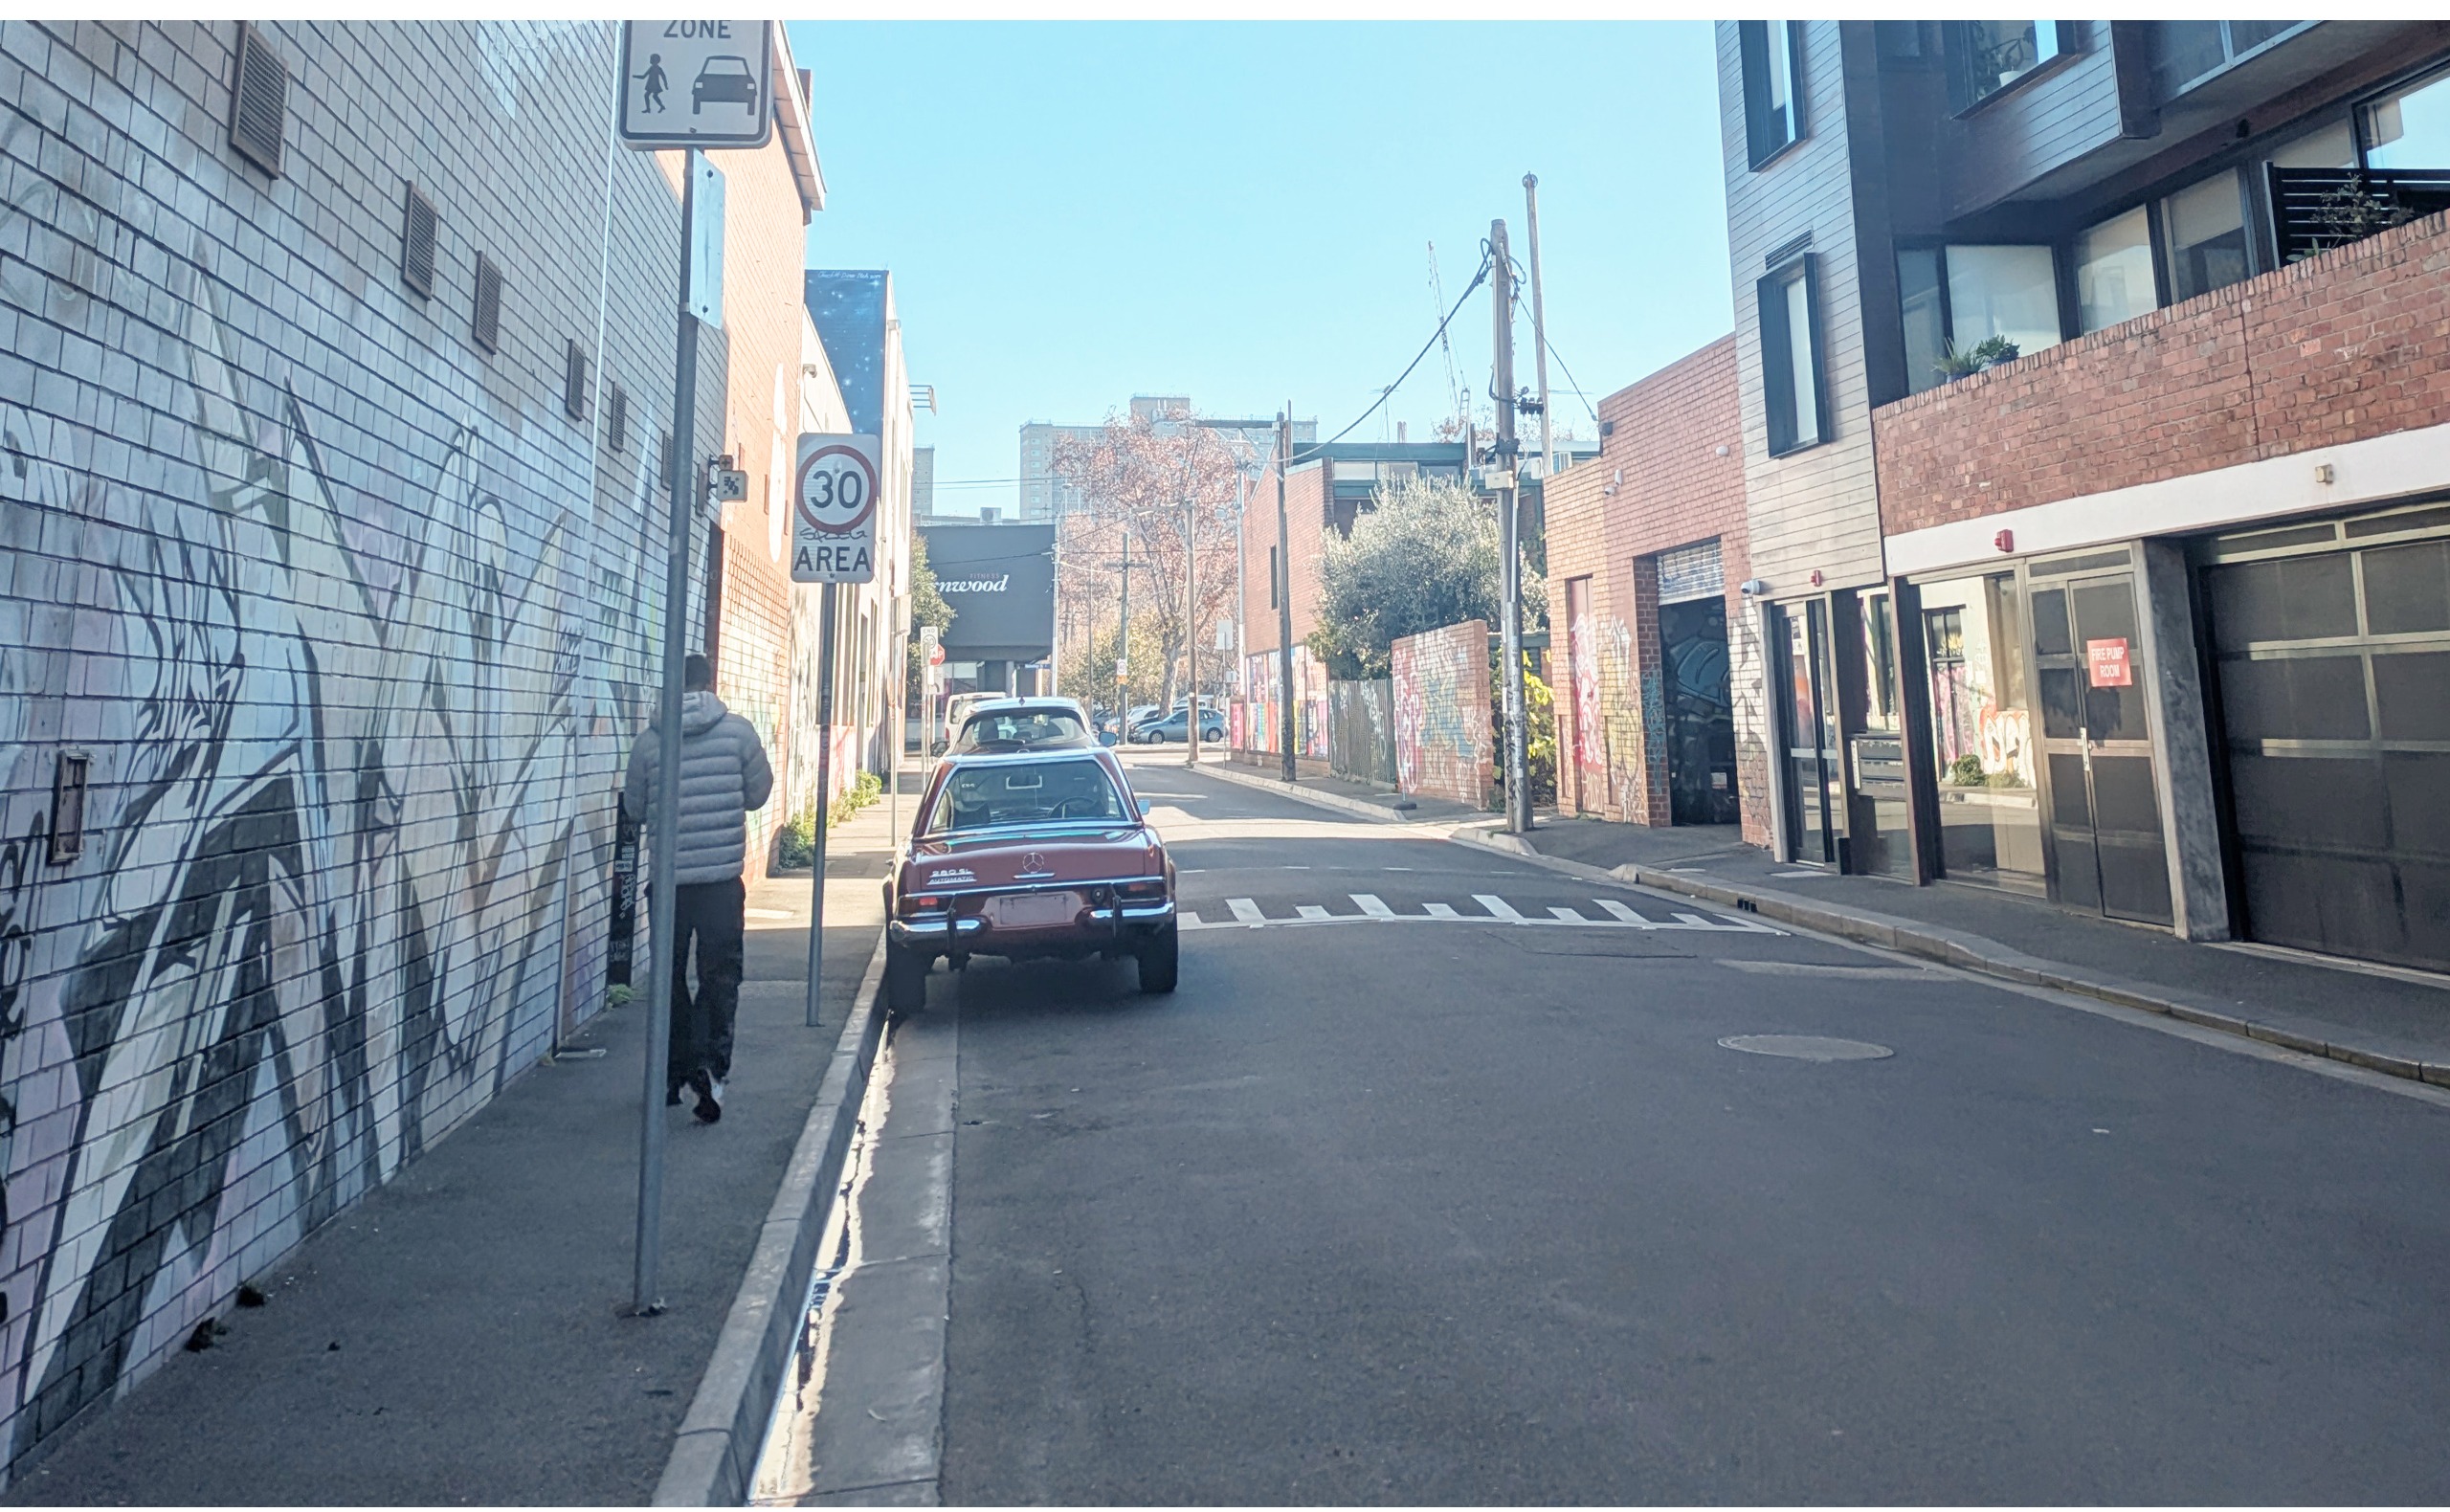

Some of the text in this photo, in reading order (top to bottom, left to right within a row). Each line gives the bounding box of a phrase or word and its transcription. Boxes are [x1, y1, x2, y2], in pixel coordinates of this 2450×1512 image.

[663, 20, 731, 39] ZONE
[810, 470, 862, 509] 30
[793, 545, 872, 572] AREA
[2091, 646, 2125, 661] FIRE PUMP
[2100, 664, 2121, 678] ROOM
